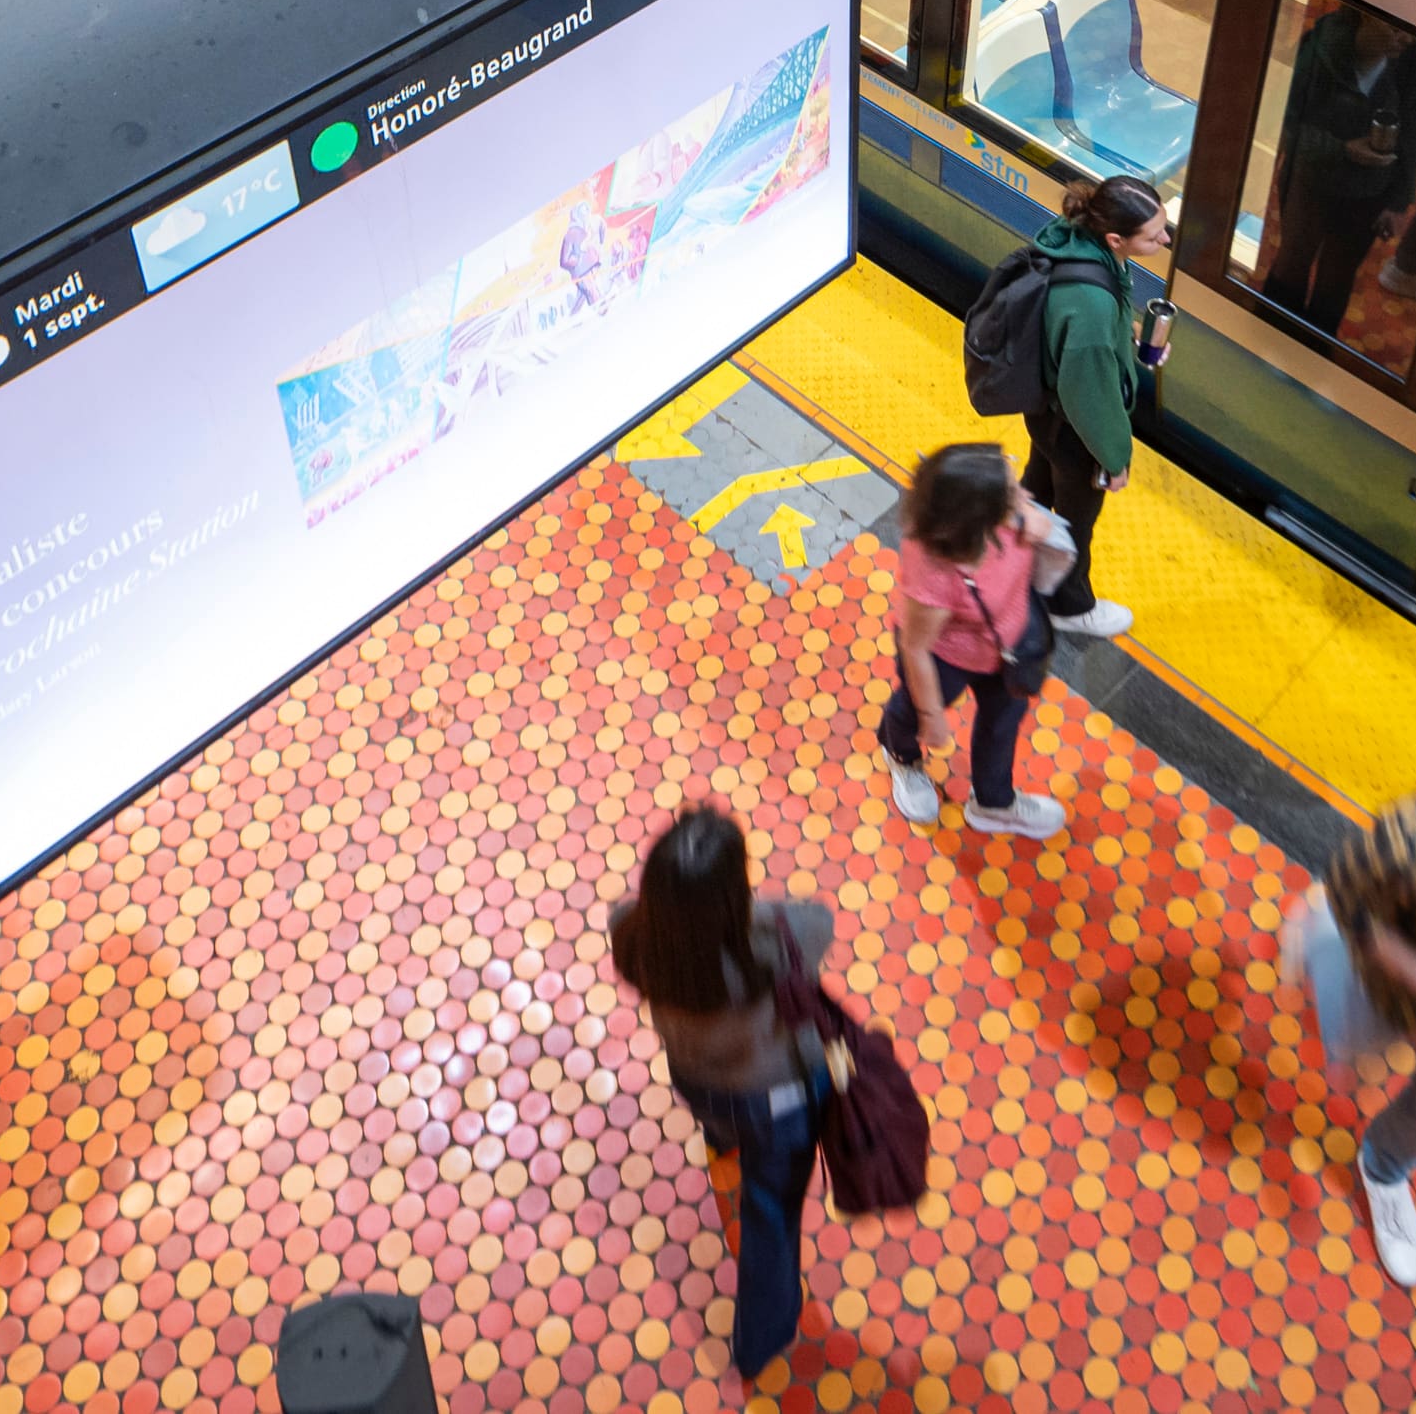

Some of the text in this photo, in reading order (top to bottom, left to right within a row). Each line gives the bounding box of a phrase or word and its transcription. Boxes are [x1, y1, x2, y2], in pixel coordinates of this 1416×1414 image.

[367, 78, 426, 122] Direction
[980, 150, 1029, 193] stm
[14, 270, 84, 326] Mardi
[23, 291, 106, 349] 1 sept.
[146, 489, 260, 582] Station
[0, 508, 165, 628] concours
